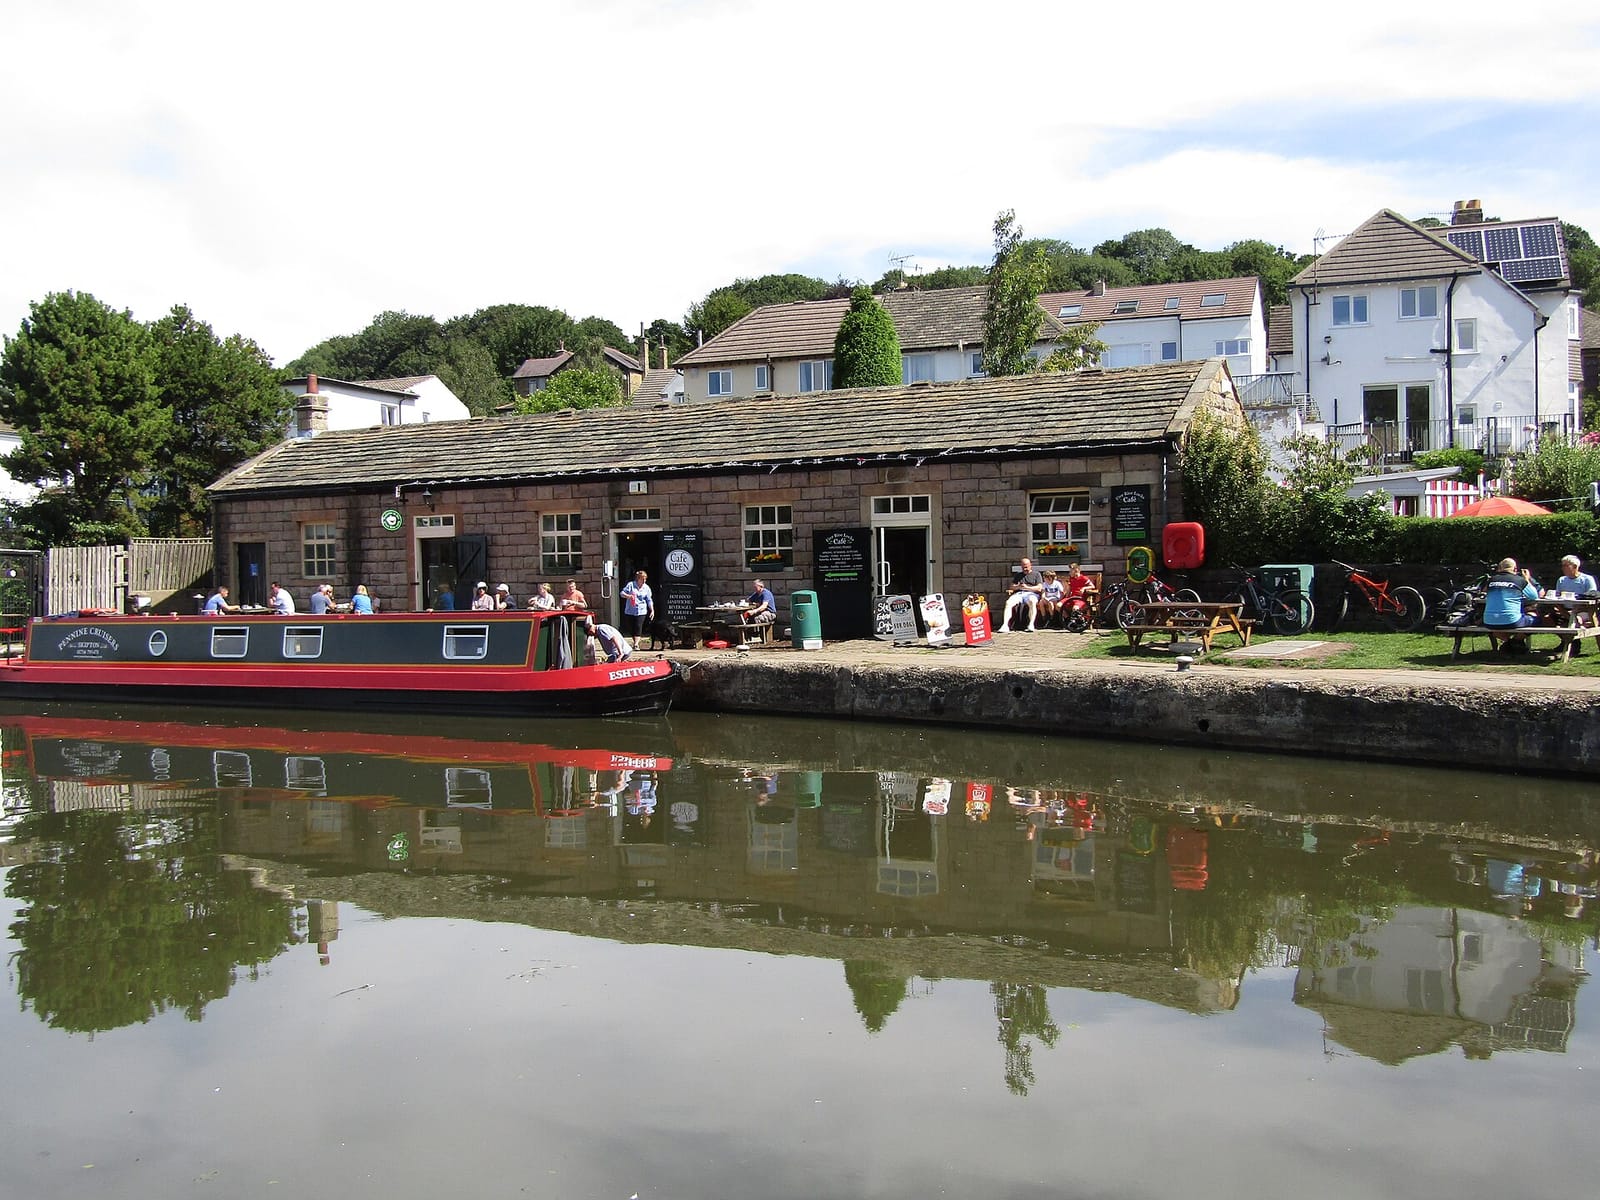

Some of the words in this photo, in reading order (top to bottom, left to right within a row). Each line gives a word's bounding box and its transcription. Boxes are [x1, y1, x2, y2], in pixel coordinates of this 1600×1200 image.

[669, 562, 689, 571] OPEN
[58, 627, 89, 651] PENNINE
[89, 627, 119, 651] CRUISERS
[609, 665, 656, 681] ESHTON
